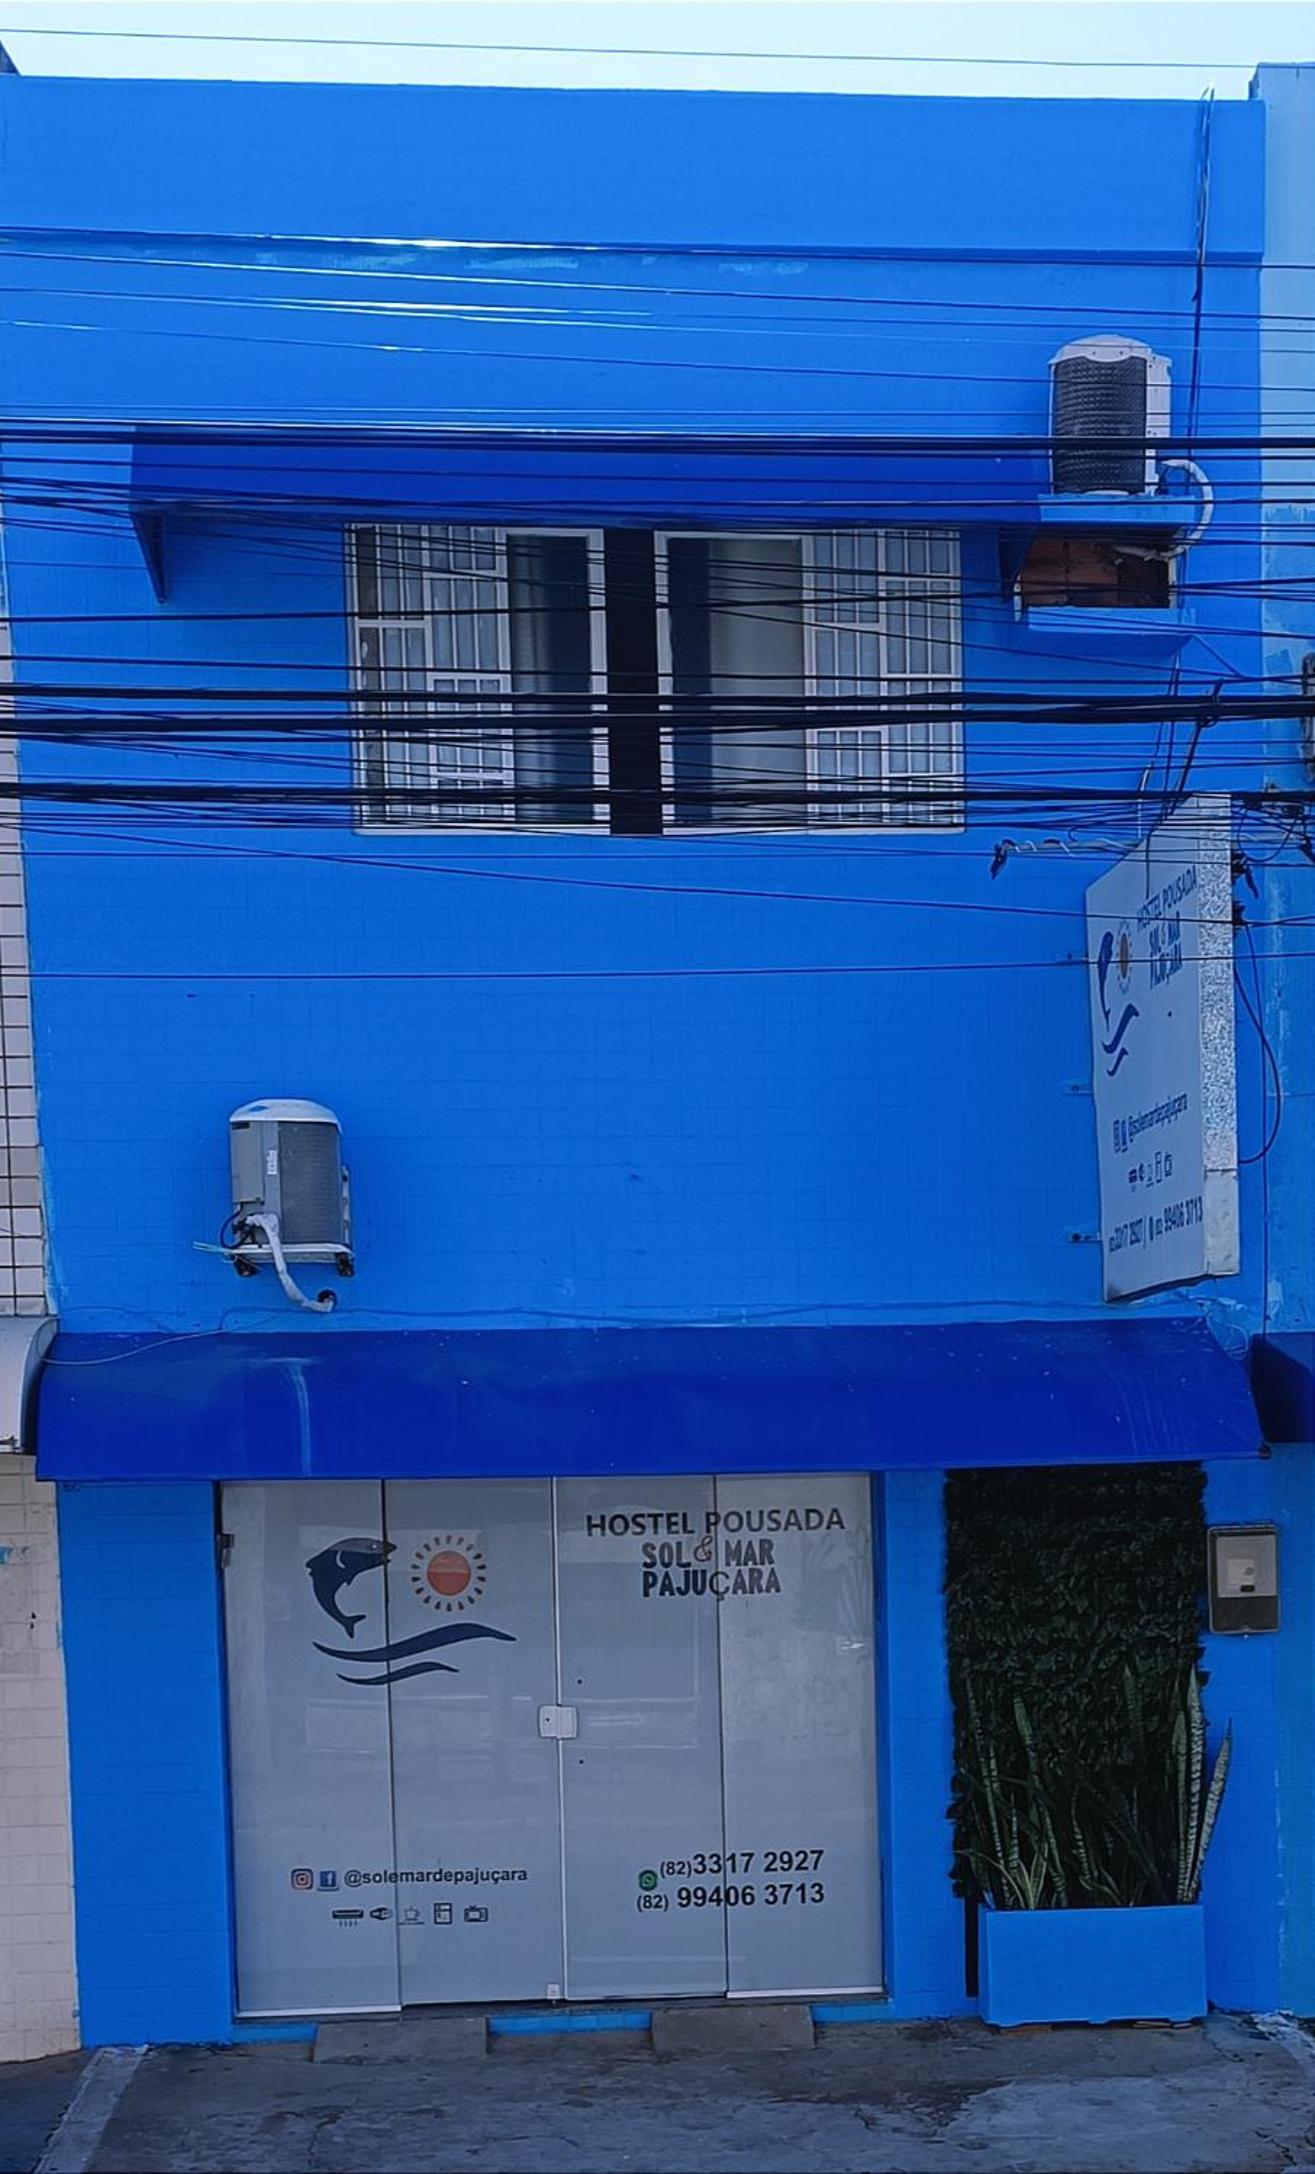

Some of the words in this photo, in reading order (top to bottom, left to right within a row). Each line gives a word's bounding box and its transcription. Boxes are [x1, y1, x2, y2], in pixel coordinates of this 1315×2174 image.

[586, 1511, 695, 1537] HOSTEL
[705, 1507, 845, 1534] POUSADA
[642, 1541, 691, 1569] SOL
[693, 1535, 713, 1562] &
[724, 1538, 775, 1567] MAR
[642, 1566, 781, 1601] PAJUÇARA
[763, 1849, 824, 1873] 2927
[344, 1867, 528, 1887] @solemardepajuçara
[637, 1894, 669, 1913] (82)
[677, 1885, 755, 1908] 99406
[764, 1882, 824, 1905] 3713
